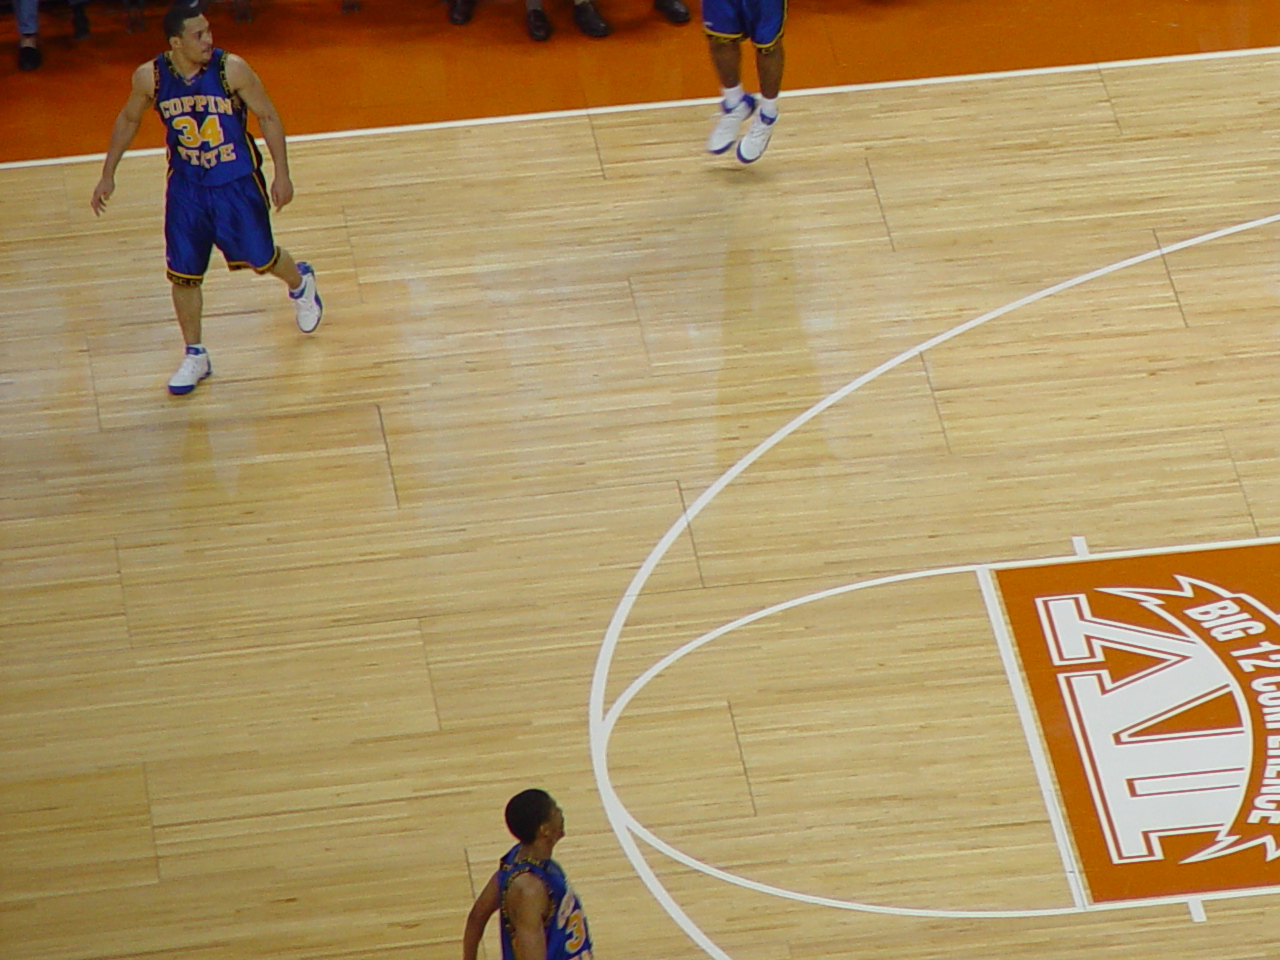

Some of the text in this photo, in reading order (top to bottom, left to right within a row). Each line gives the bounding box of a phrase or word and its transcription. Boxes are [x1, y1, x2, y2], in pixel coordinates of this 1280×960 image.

[159, 94, 233, 120] COPPIN
[172, 114, 225, 149] 34
[1183, 599, 1266, 643] BIG
